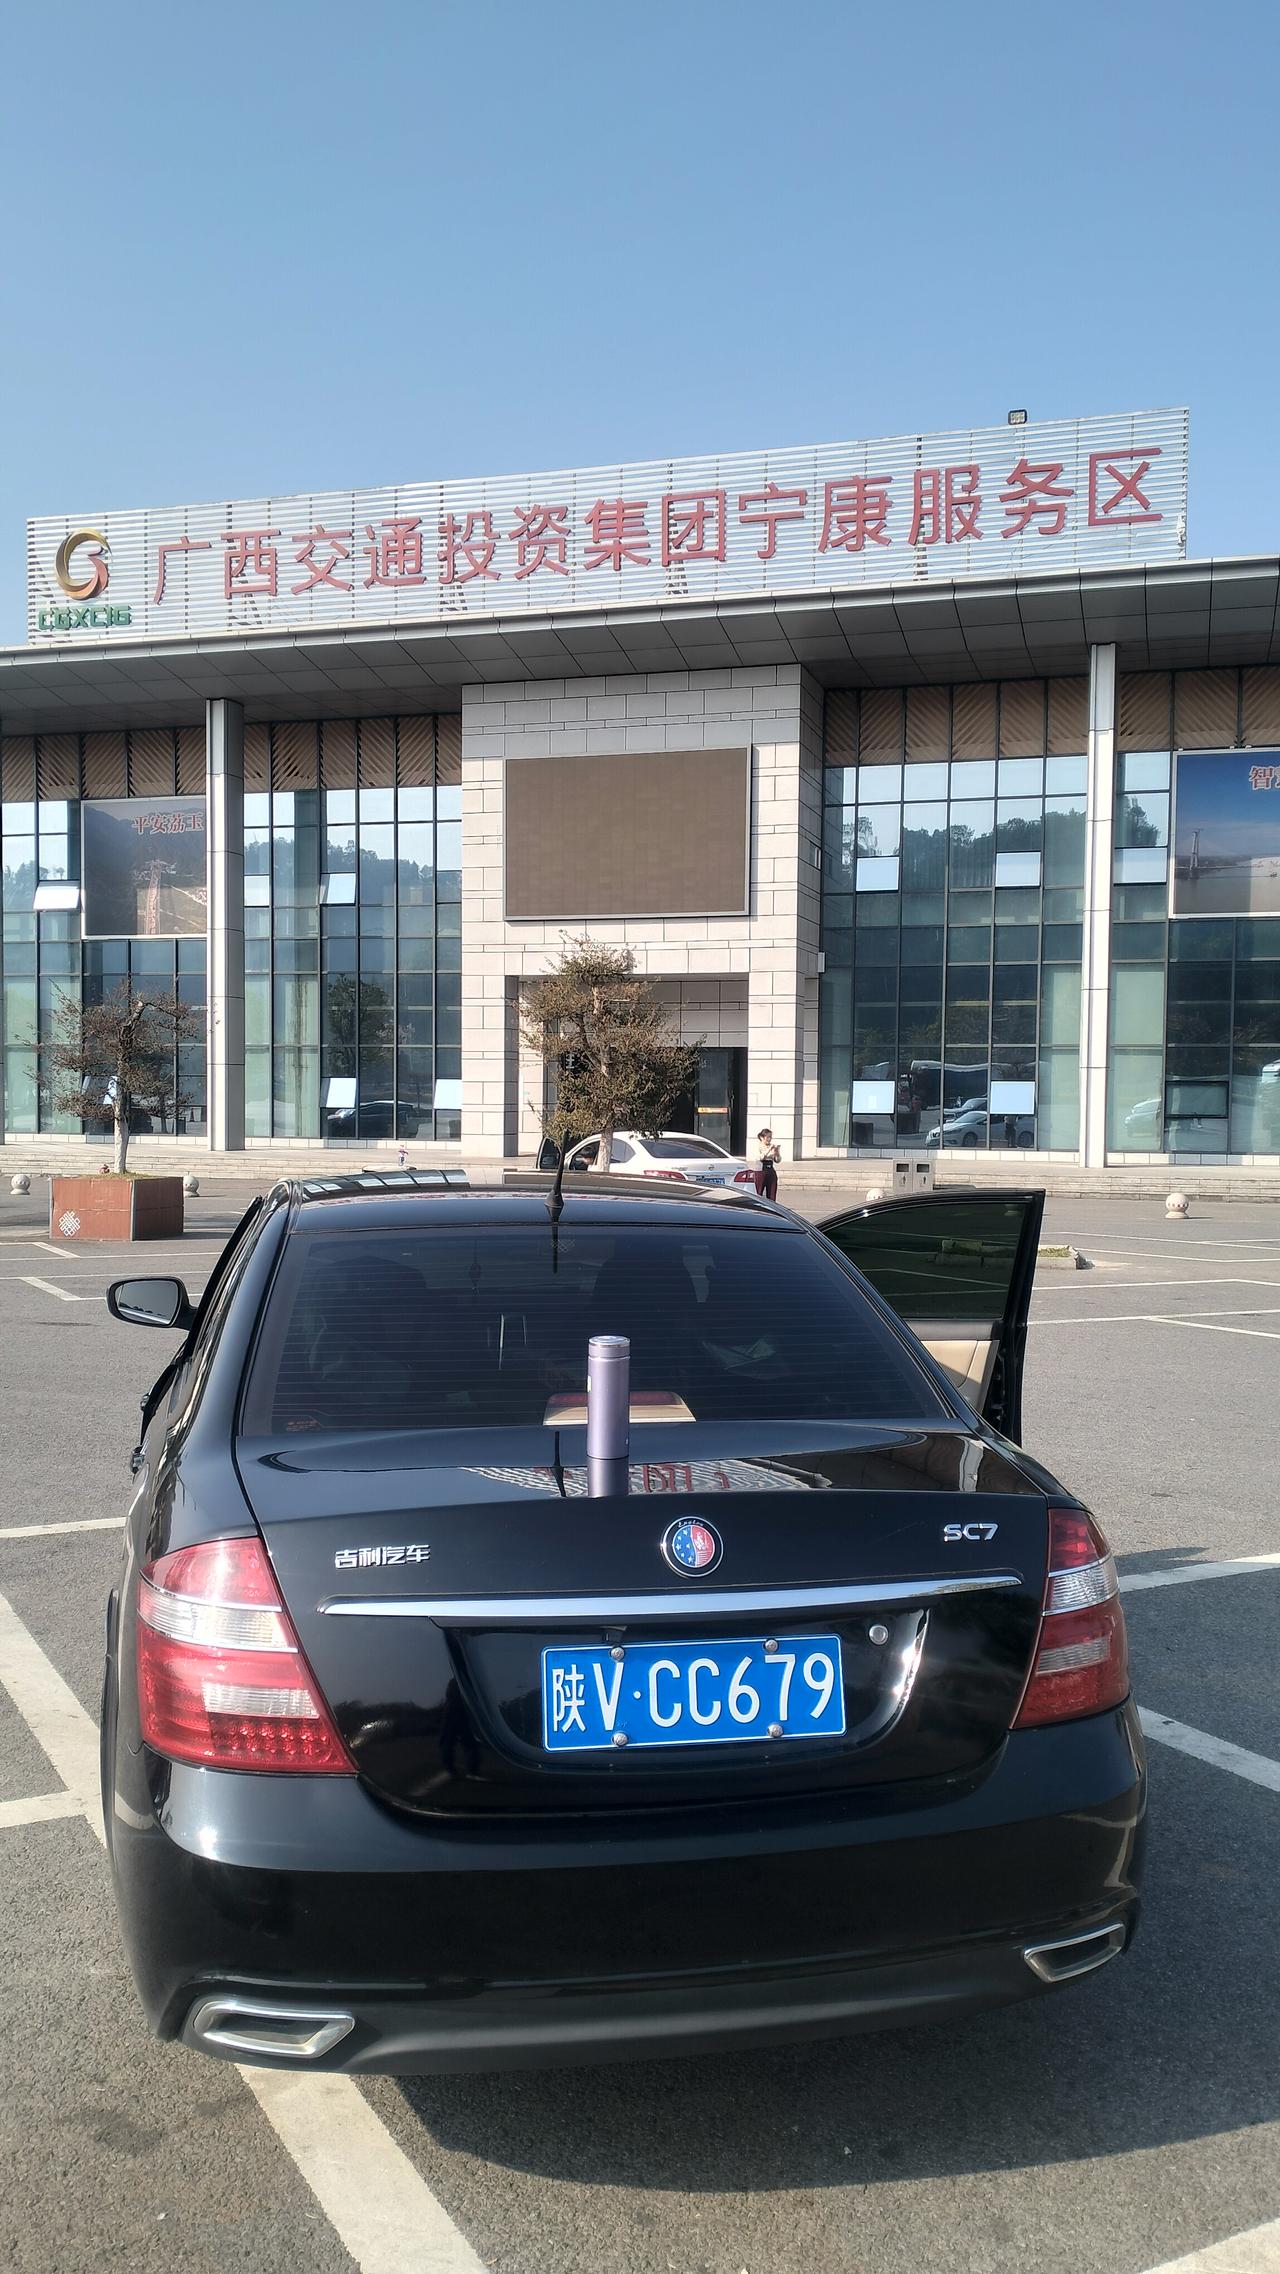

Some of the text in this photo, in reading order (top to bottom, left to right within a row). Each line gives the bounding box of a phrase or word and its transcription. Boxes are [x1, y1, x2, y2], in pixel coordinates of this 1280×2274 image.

[152, 447, 1164, 606] 广西交通投资集团宁康服务区
[131, 811, 205, 835] 平安荔玉
[943, 1523, 999, 1542] SC7
[334, 1544, 431, 1569] 吉利汽车
